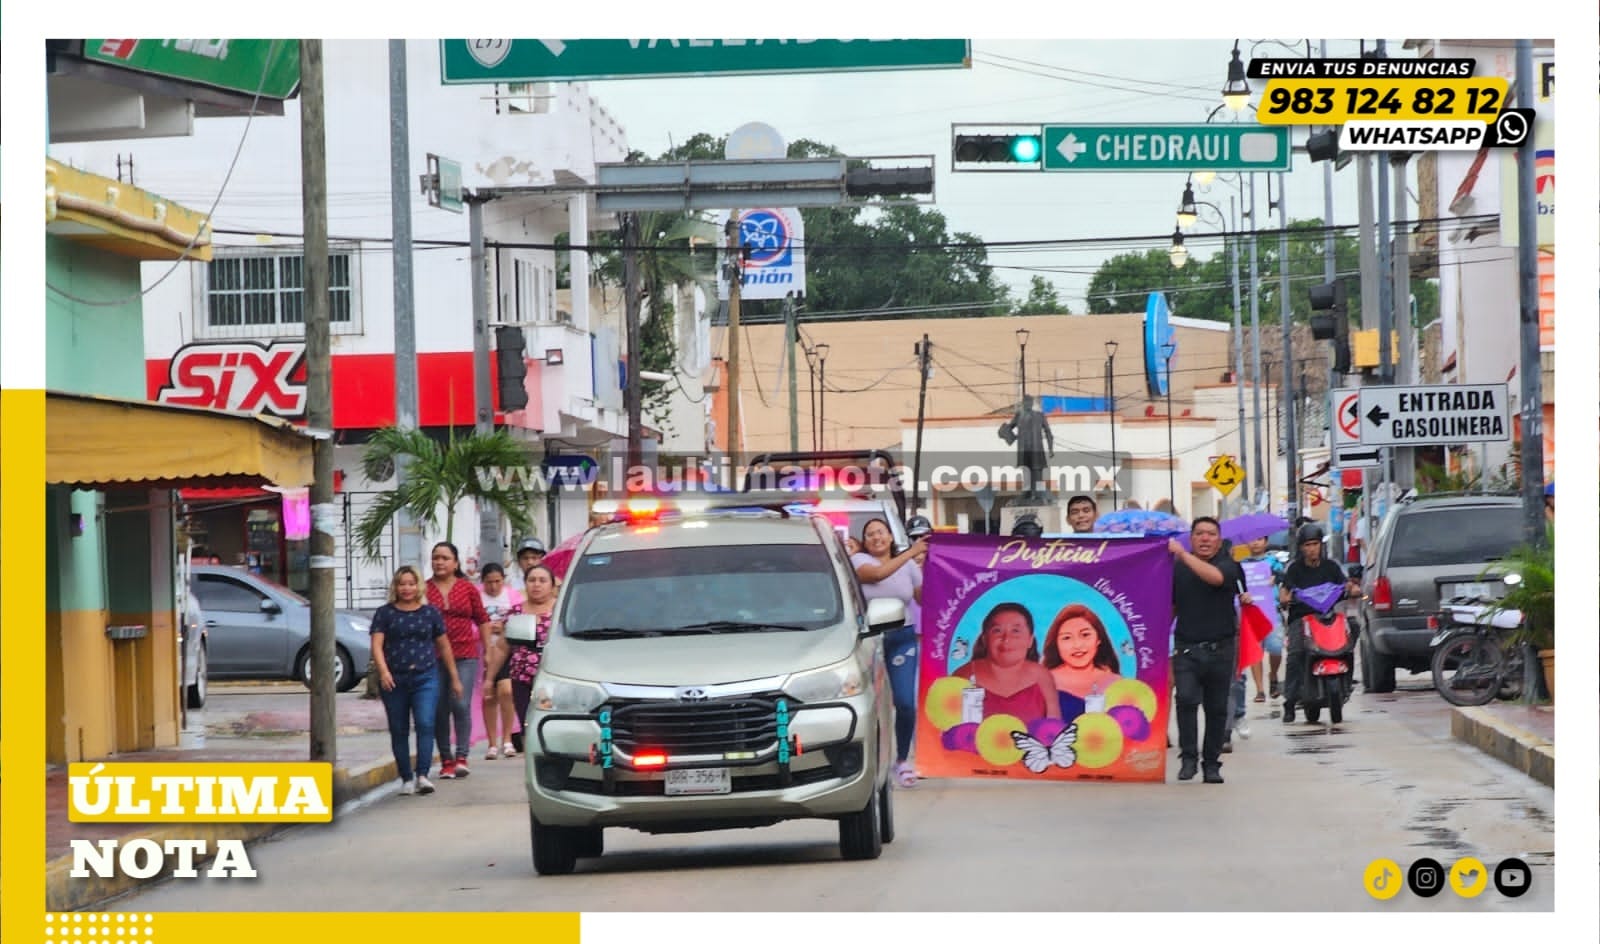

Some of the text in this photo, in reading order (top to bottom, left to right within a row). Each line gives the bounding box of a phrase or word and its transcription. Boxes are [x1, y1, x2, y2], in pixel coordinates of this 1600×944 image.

[1095, 134, 1231, 162] CHEDRAUI
[1398, 390, 1496, 413] ENTRADA
[1391, 415, 1504, 439] GASOLINERA
[987, 539, 1109, 569] ¡Justicia!
